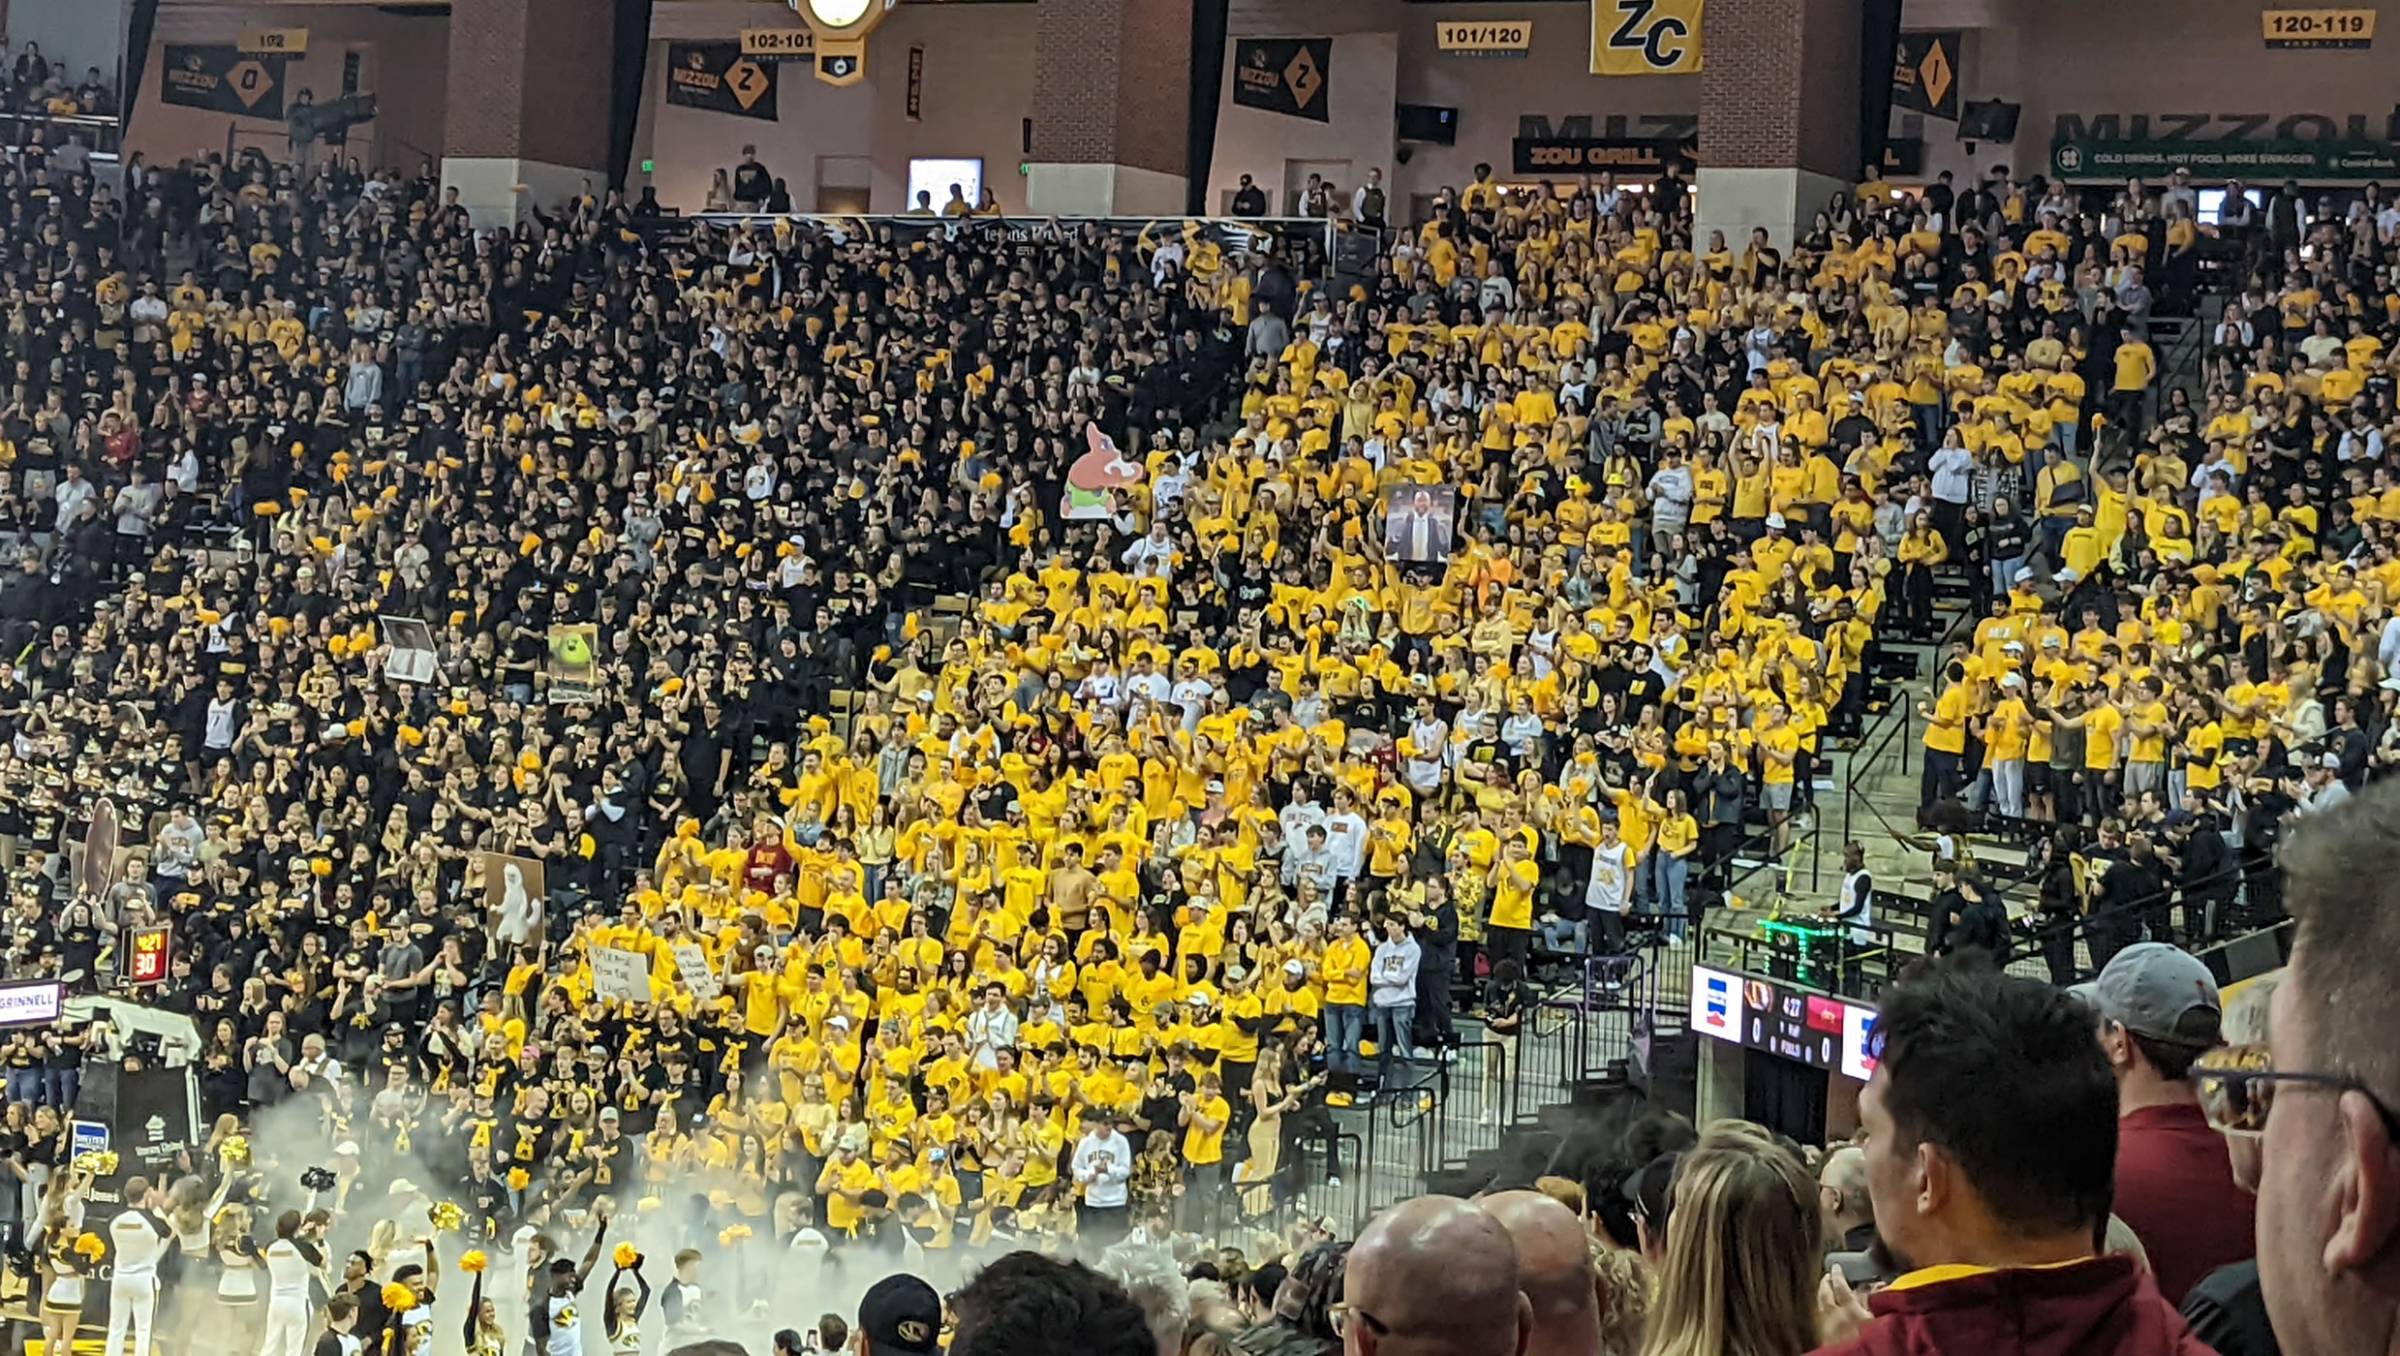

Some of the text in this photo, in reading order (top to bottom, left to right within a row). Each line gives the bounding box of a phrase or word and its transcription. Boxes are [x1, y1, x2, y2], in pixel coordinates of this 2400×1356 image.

[2272, 15, 2364, 33] 120-119
[259, 33, 285, 48] 102
[748, 33, 813, 49] 102-101
[1444, 27, 1523, 44] 101/120
[1608, 0, 1688, 68] ZC
[1530, 148, 1661, 165] ZOU GRILL
[135, 952, 156, 976] 30
